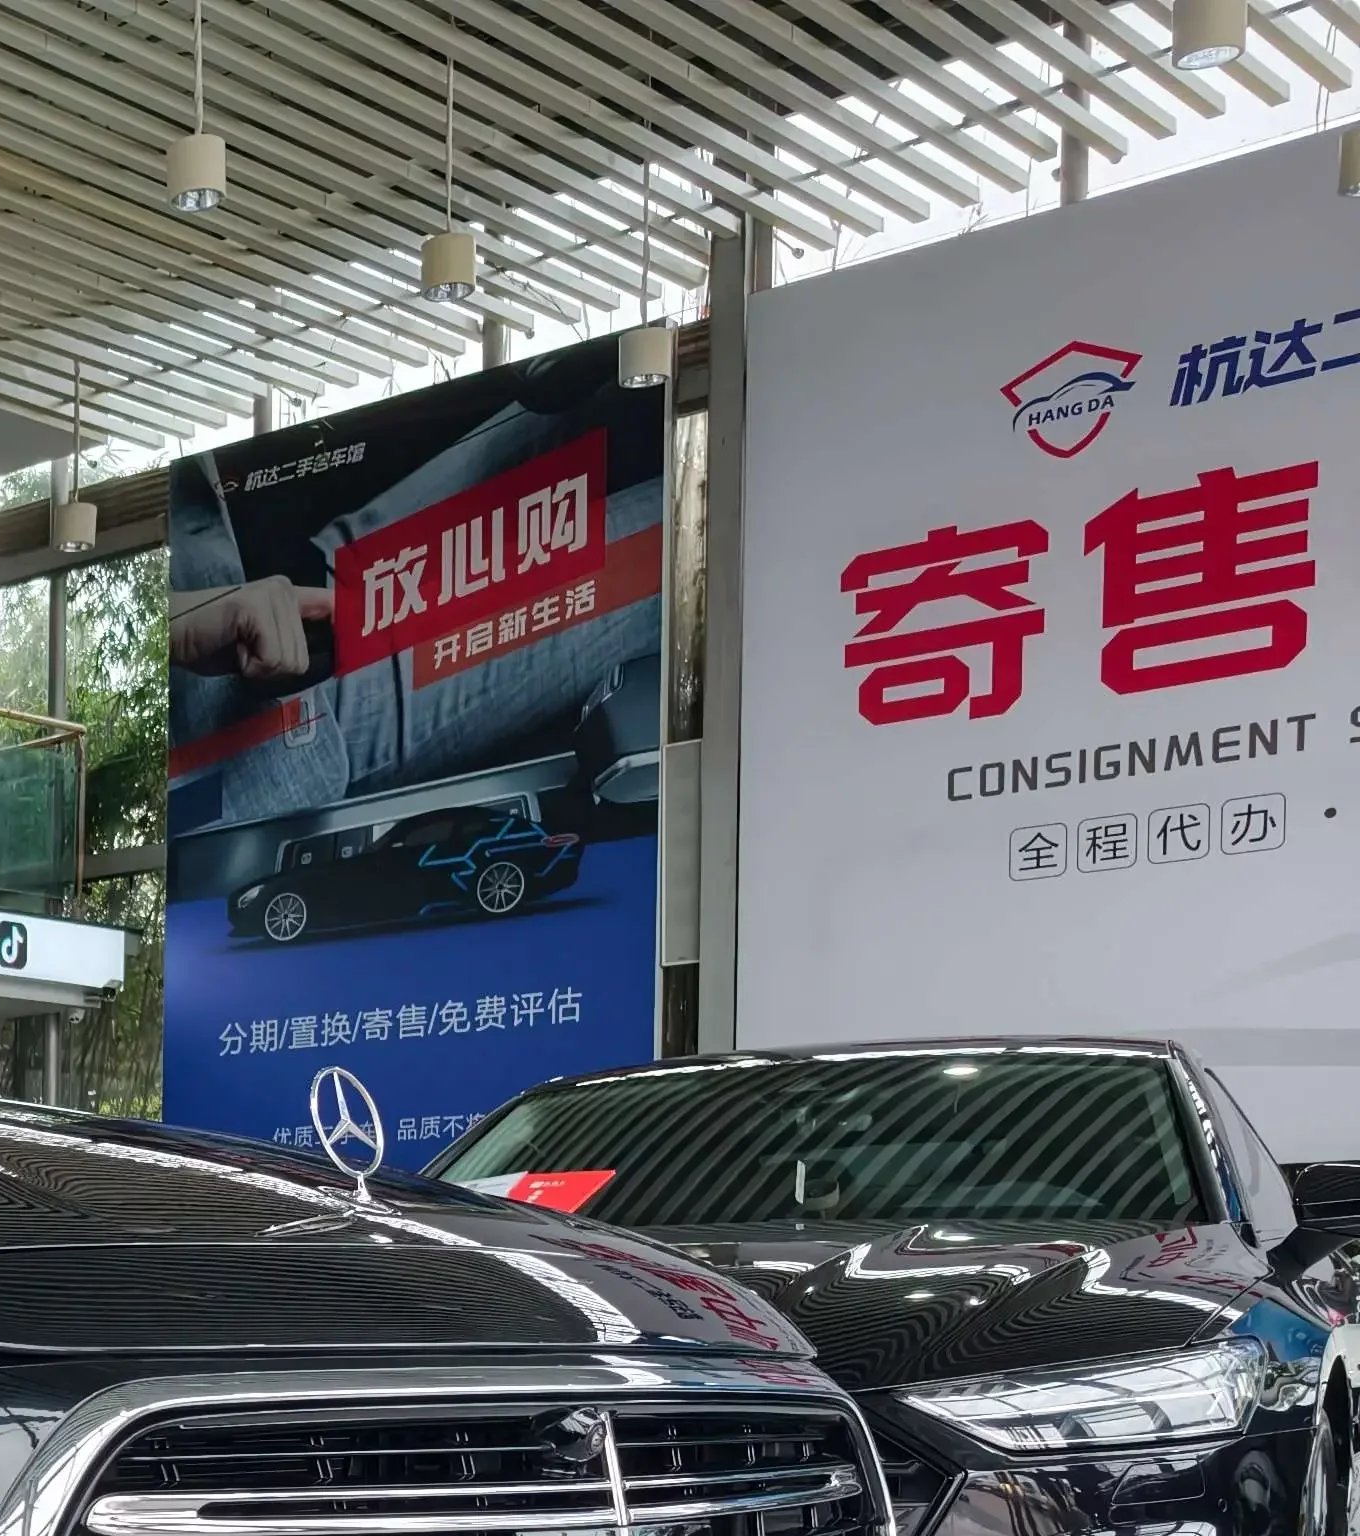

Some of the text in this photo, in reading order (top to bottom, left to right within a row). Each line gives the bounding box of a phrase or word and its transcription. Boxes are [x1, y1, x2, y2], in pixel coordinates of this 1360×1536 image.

[1026, 395, 1115, 428] HANG DA
[362, 473, 588, 637] 放心购
[840, 461, 1319, 726] 寄售
[433, 580, 596, 670] 开启新生活
[947, 712, 1317, 802] CONSIGNMENT
[1017, 803, 1277, 874] 全程代办
[218, 987, 583, 1057] 分期/置换/寄售/免费评估
